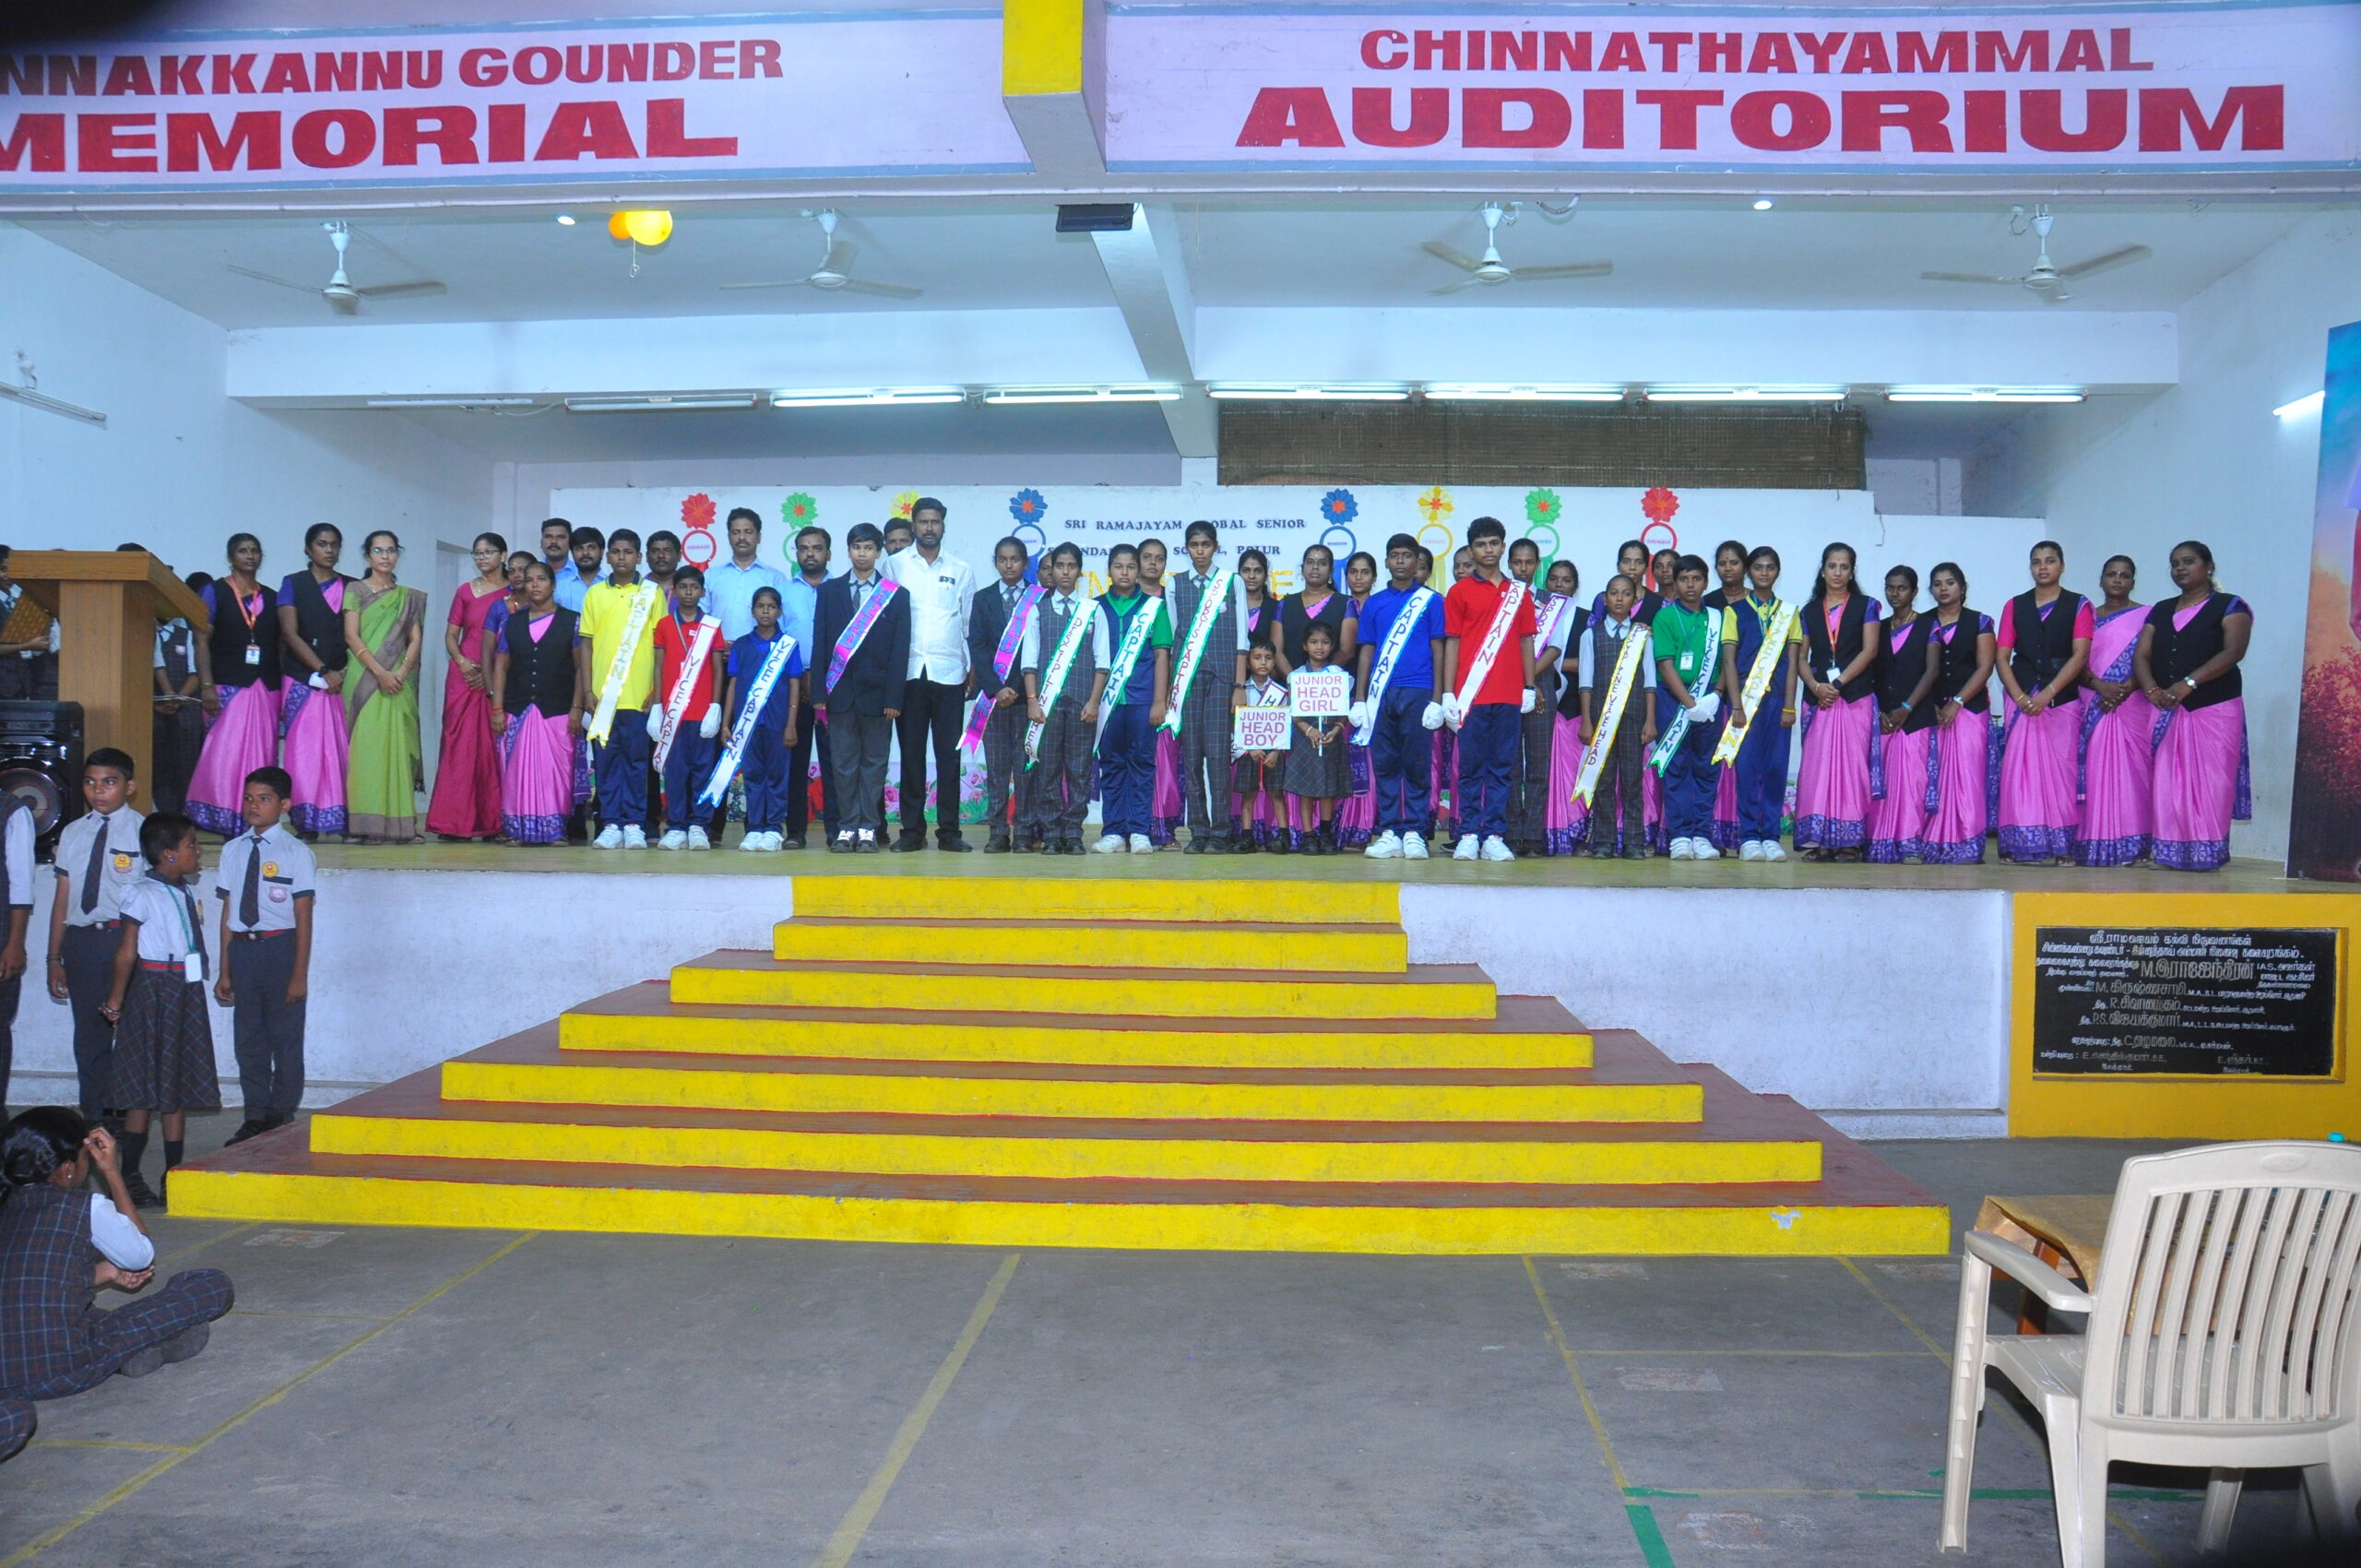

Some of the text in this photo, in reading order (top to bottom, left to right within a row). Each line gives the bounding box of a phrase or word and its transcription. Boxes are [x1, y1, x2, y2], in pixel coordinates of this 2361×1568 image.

[459, 39, 784, 89] GOUNDER
[1360, 28, 2154, 74] CHINNATHAYAMMAL
[1235, 84, 2285, 153] AUDITORIUM
[1064, 519, 1306, 532] SRI RAMAJAYAM OBAL SENIOR
[1169, 578, 1223, 713] SPORTS CAPTAIN
[1477, 581, 1521, 666] CAPTAIN
[1102, 612, 1149, 707] CAPTAIN
[1370, 596, 1422, 698] CAPTAIN
[726, 640, 790, 761] VICE CAPTAIN
[1295, 675, 1343, 685] JUNIOR
[1297, 686, 1342, 698] HEAD
[1660, 628, 1718, 754] VICE CATAIN
[653, 656, 701, 770] VICE CAPTAI
[1240, 711, 1287, 721] JUNIOR
[1240, 721, 1285, 734] HEAD
[1299, 699, 1338, 712] GIRL
[1243, 733, 1278, 747] BOY
[1587, 730, 1607, 766] HEAD
[2164, 932, 2189, 945] கல்வி
[2192, 932, 2251, 946] நிறுவனங்கள்
